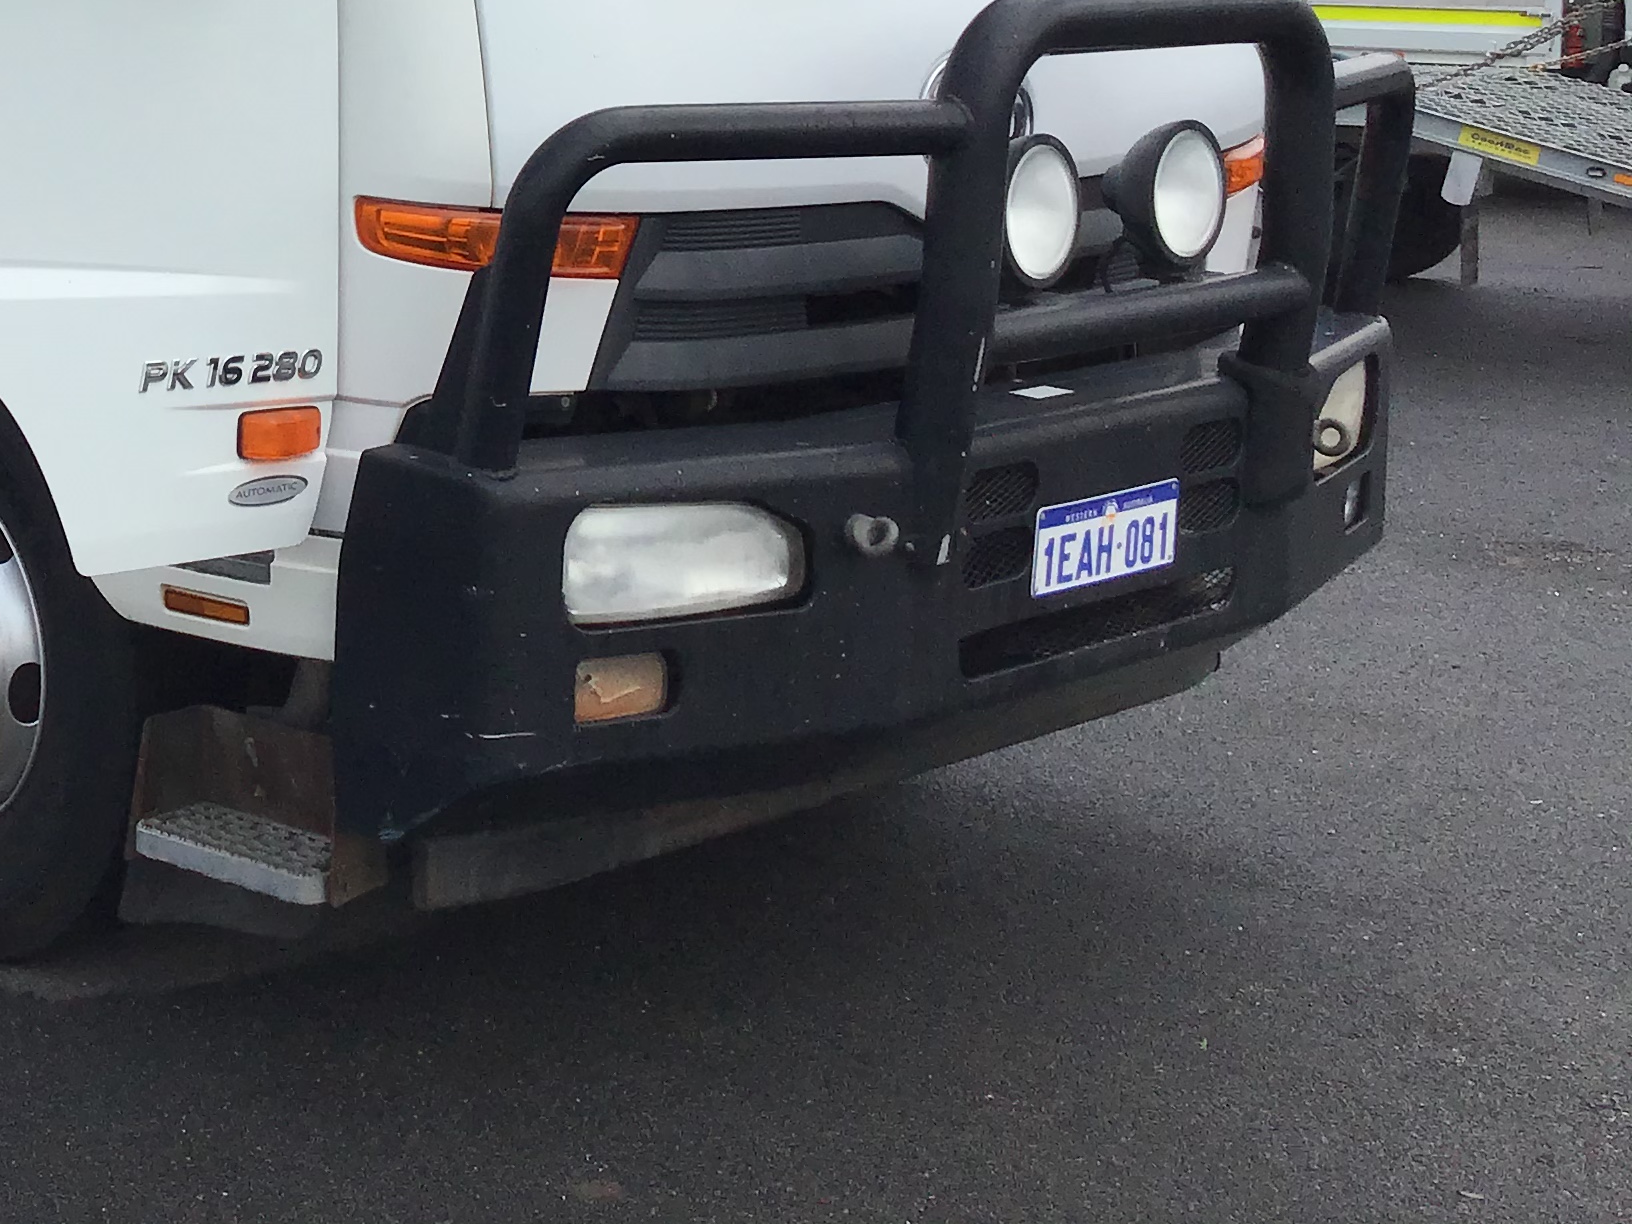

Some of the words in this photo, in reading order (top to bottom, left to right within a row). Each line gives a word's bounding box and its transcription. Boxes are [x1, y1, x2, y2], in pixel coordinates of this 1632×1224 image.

[138, 357, 198, 394] PK
[206, 355, 245, 388] 16
[248, 349, 323, 385] 280
[234, 481, 298, 500] AUTOMATIC
